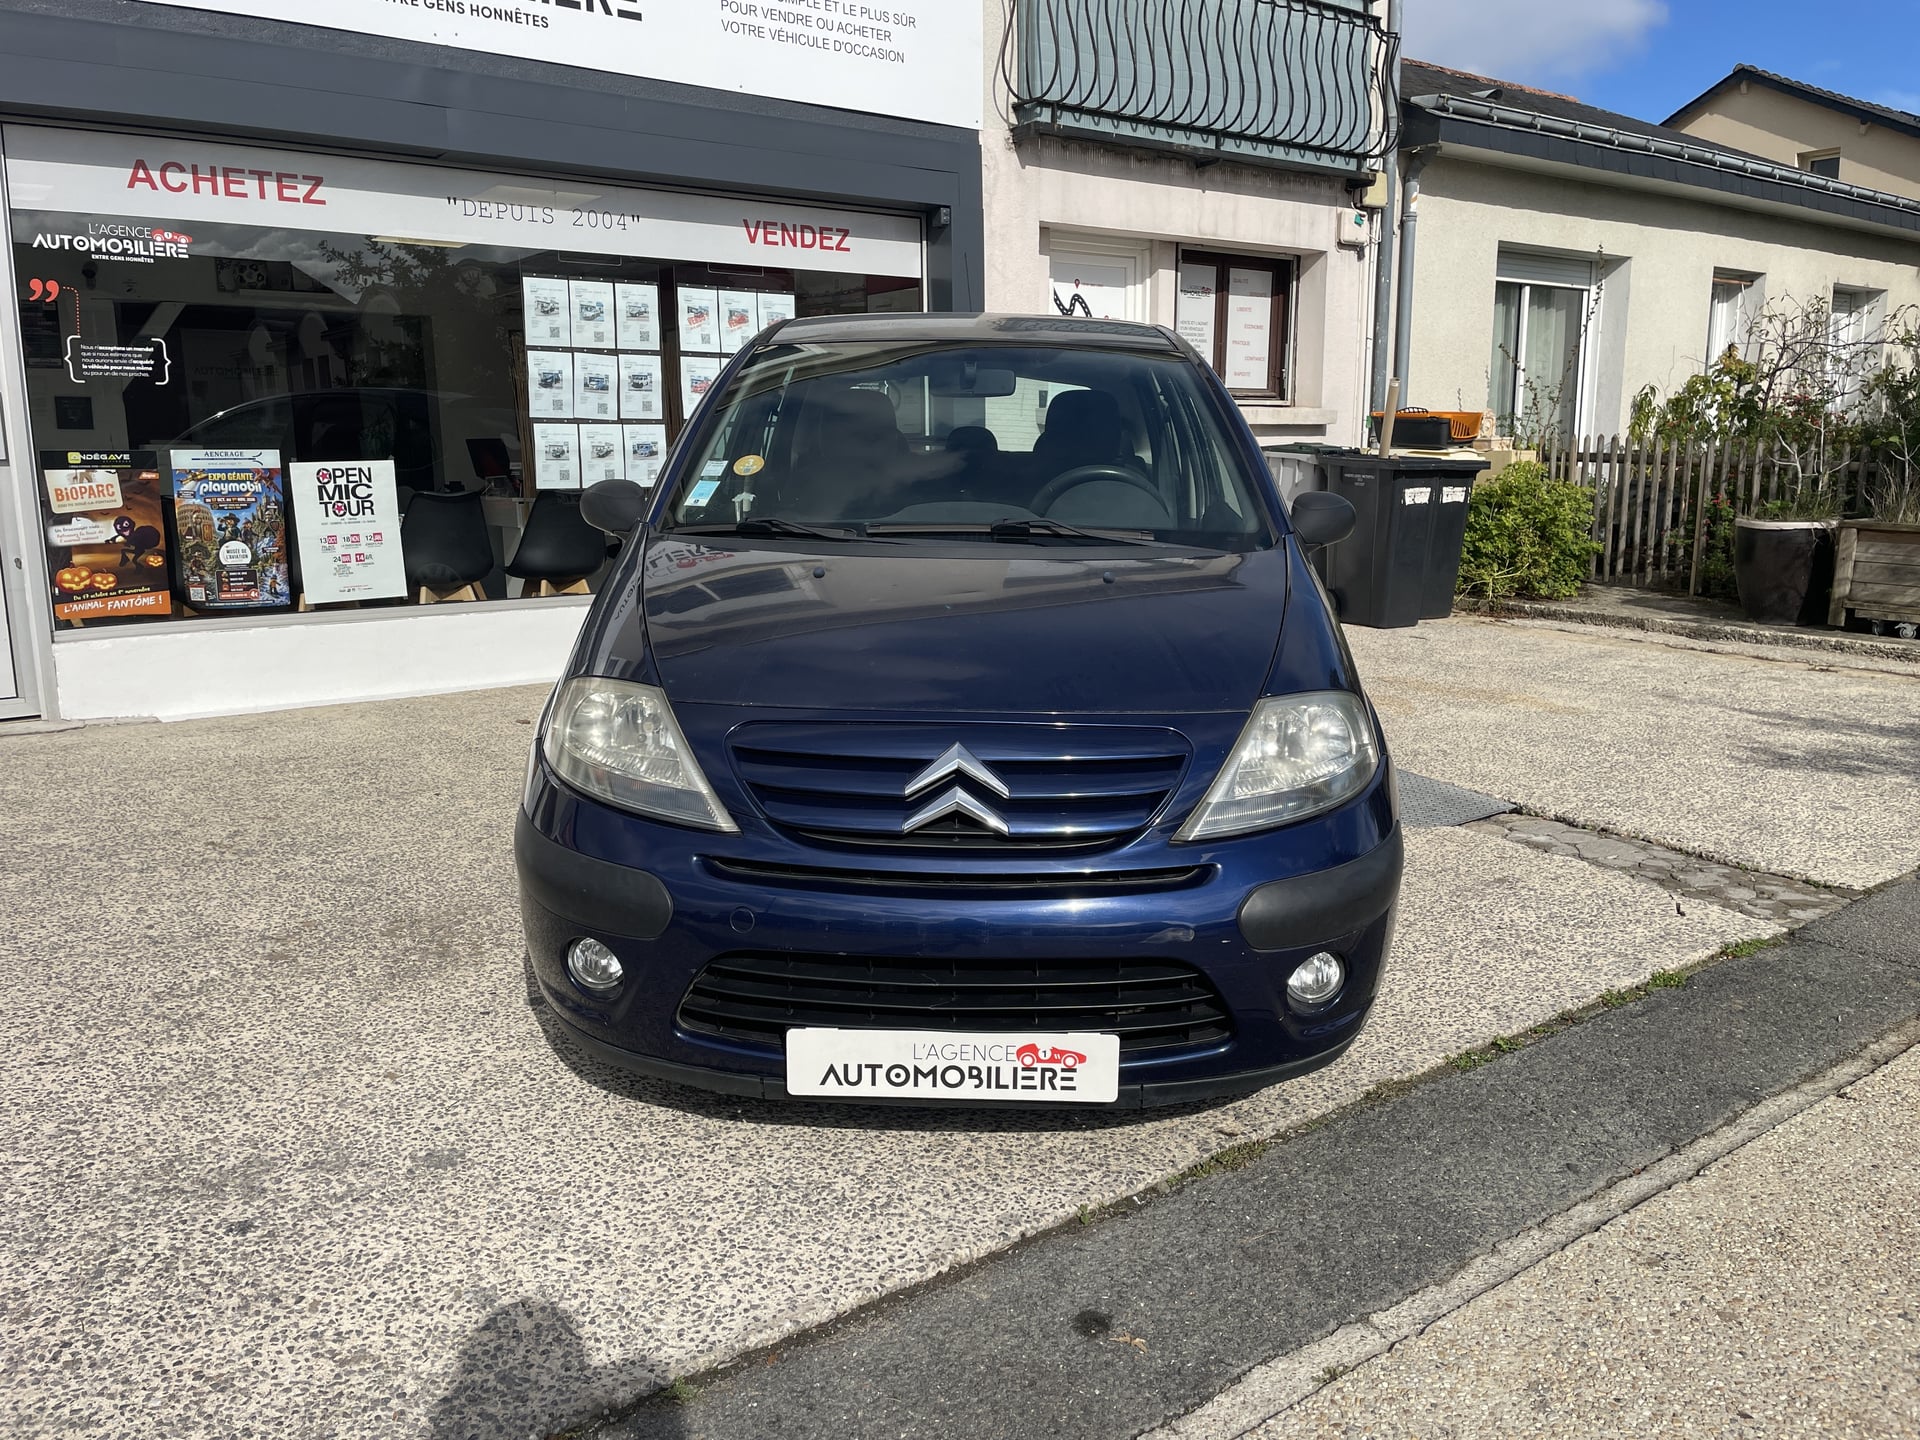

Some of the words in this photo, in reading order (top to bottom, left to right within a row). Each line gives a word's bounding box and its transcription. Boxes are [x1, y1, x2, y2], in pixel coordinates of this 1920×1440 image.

[423, 0, 465, 14] GENS
[470, 3, 549, 28] HONNÊTES
[721, 0, 758, 17] POUR
[761, 6, 813, 28] VENDRE
[816, 17, 834, 32] OU
[837, 21, 892, 42] ACHETER
[825, 0, 839, 13] ET
[843, 3, 857, 16] LE
[860, 6, 890, 23] PLUS
[893, 12, 916, 29] SÛR
[721, 19, 765, 39] VOTRE
[769, 27, 830, 50] VÉHICULE
[834, 40, 905, 64] D'OCCASION
[127, 159, 327, 205] ACHETEZ
[446, 196, 555, 225] "DEPUIS
[572, 208, 640, 231] 2004"
[88, 223, 152, 239] L'AGENCE
[742, 218, 851, 253] VENDEZ
[227, 472, 254, 480] GÉANTE
[316, 467, 372, 484] OPEN
[200, 481, 262, 496] playmobil
[317, 483, 373, 501] MIC
[319, 500, 375, 517] TOUR
[64, 600, 105, 613] L'ANIMAL
[107, 595, 156, 611] FANTÔME
[913, 1043, 1016, 1062] L'AGENCE
